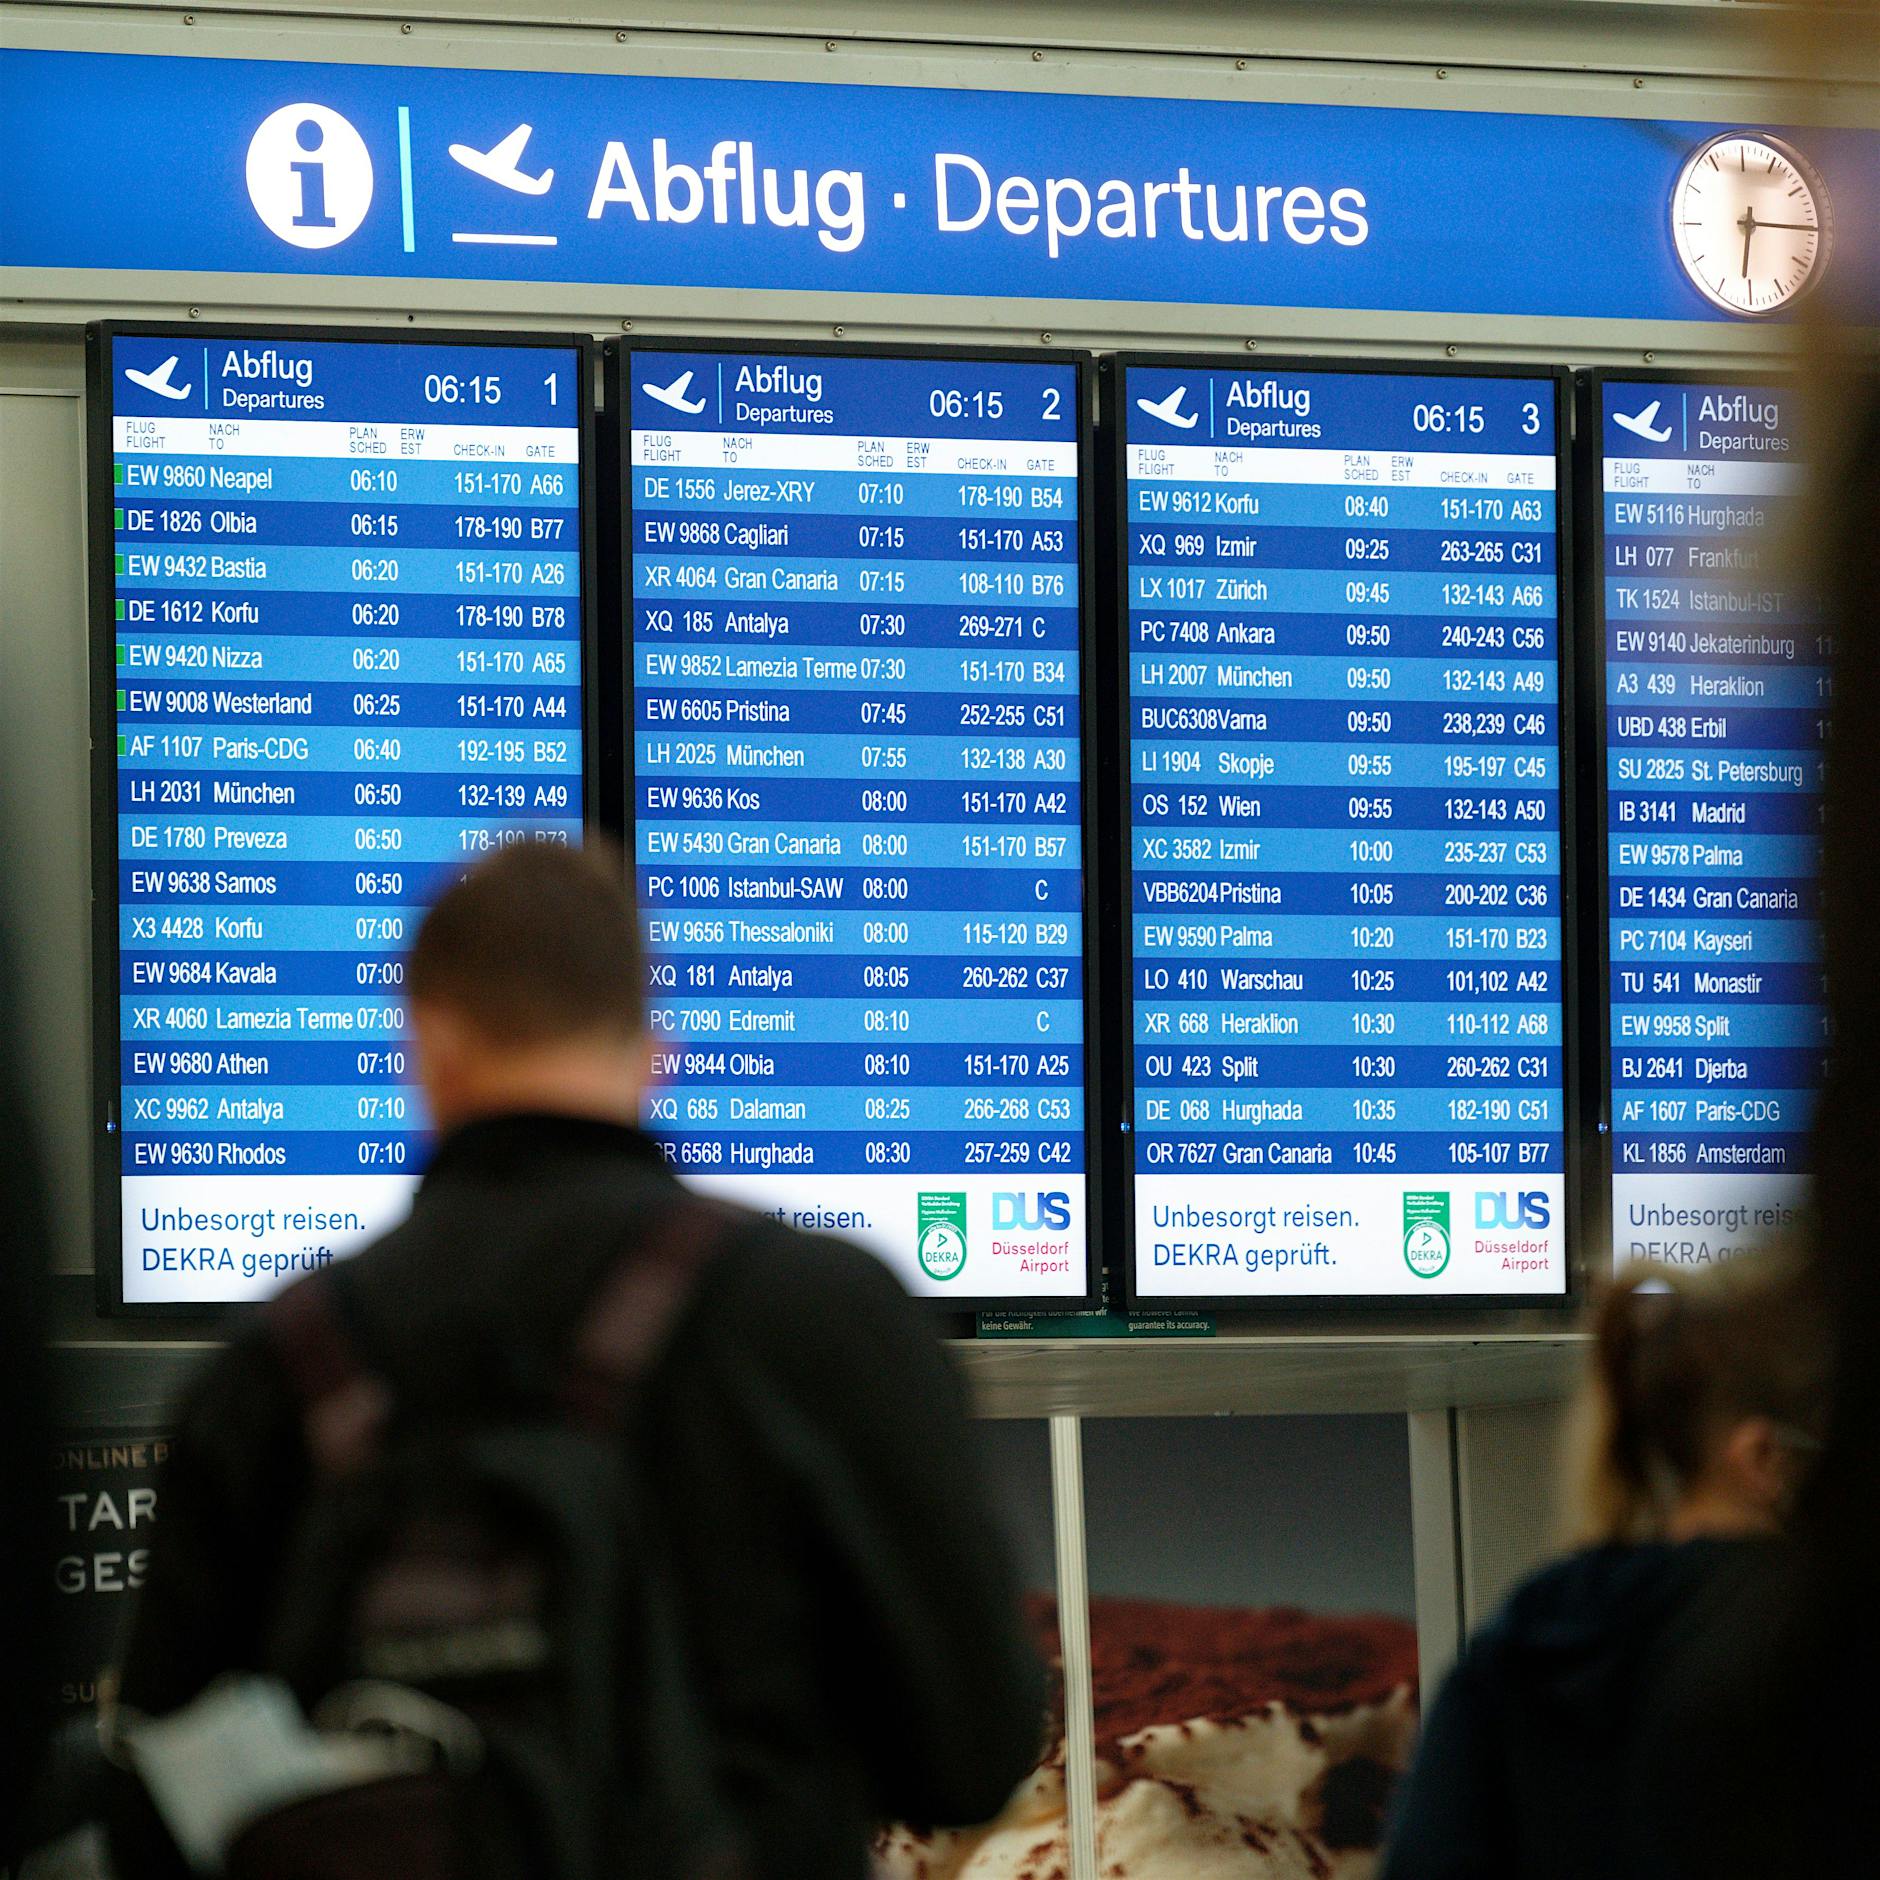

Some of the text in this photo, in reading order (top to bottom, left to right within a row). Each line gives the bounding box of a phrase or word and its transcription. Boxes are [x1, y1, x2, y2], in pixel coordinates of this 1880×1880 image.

[588, 138, 1368, 258] Abflug Departures
[222, 350, 312, 387] Abflug
[425, 373, 556, 405] 06:15 1
[735, 365, 821, 402] Abflug
[224, 388, 324, 412] Departures
[930, 388, 1060, 420] 06:15 2
[1227, 380, 1310, 416] Abflug
[737, 403, 833, 426] Departures
[1414, 403, 1540, 434] 06:15 3
[1698, 395, 1778, 429] Abflug
[126, 421, 425, 440] FLUG NACH PLAN ERW
[1228, 418, 1321, 440] Departures
[127, 436, 555, 457] FLIGHT TO SCHED EST CHECK-IN GATE
[644, 435, 930, 454] FLUG NACH PLAN ERW
[1700, 430, 1789, 453] Departures
[644, 449, 1055, 471] FLIGHT TO SCHED EST CHECK-IN GATE
[1138, 449, 1413, 467] FLUG NACH PLAN ERW
[1614, 463, 1714, 476] FLUG NACH
[128, 465, 563, 495] EW 9860 Neapel 06:10 151-170 A66
[1139, 463, 1533, 484] FLIGHT TO SCHED EST CHECK-IN GATE
[1614, 476, 1701, 489] FLIGHT TO
[645, 478, 1063, 508] DE 1556 Jerez-XRY 07:10 178-190 B54
[1141, 578, 1542, 606] LX 1017 Zürich 09:45 132-143 A66
[130, 600, 565, 628] DE 1612 Korfu 06:20 178-190 B78
[647, 699, 1063, 726] EW 6605 Pristina 07:45 252-255 C51
[1618, 716, 1726, 738] UBD 438 Erbil
[132, 781, 567, 807] LH 2031 München 06:50 132-139 A49
[1620, 887, 1797, 908] DE 1434 Gran Canaria
[650, 921, 1067, 944] EW 9656 Thessaloniki 08:00 115-120 B29
[134, 962, 403, 984] EW 9684 Kavala 07:00
[1145, 969, 1547, 994] LO 410 Warschau 10:25 101,102 A42
[1622, 1058, 1747, 1083] BJ 2641 Djerba
[136, 1142, 405, 1164] EW 9630 Rhodos 07:10
[1147, 1143, 1549, 1163] OR 7627 Gran Canaria 10:45 105-107 B77
[142, 1206, 367, 1237] Unbesorgt reisen.
[793, 1206, 872, 1229] reisen.
[992, 1191, 1071, 1231] DUS
[1153, 1203, 1359, 1234] Unbesorgt reisen.
[1475, 1191, 1550, 1230] DUS
[1629, 1203, 1748, 1232] Unbesorgt
[925, 1251, 959, 1263] DEKRA
[992, 1241, 1069, 1255] Düsseldorf
[1154, 1242, 1336, 1273] DEKRA geprüft.
[1409, 1250, 1442, 1261] DEKRA
[1475, 1240, 1548, 1253] Düsseldorf
[142, 1247, 235, 1271] DEKRA
[1020, 1259, 1069, 1275] Airport
[1502, 1257, 1548, 1273] Airport
[982, 1321, 1034, 1331] keine Gewähr.
[1128, 1320, 1210, 1332] guarantee its accuracy.
